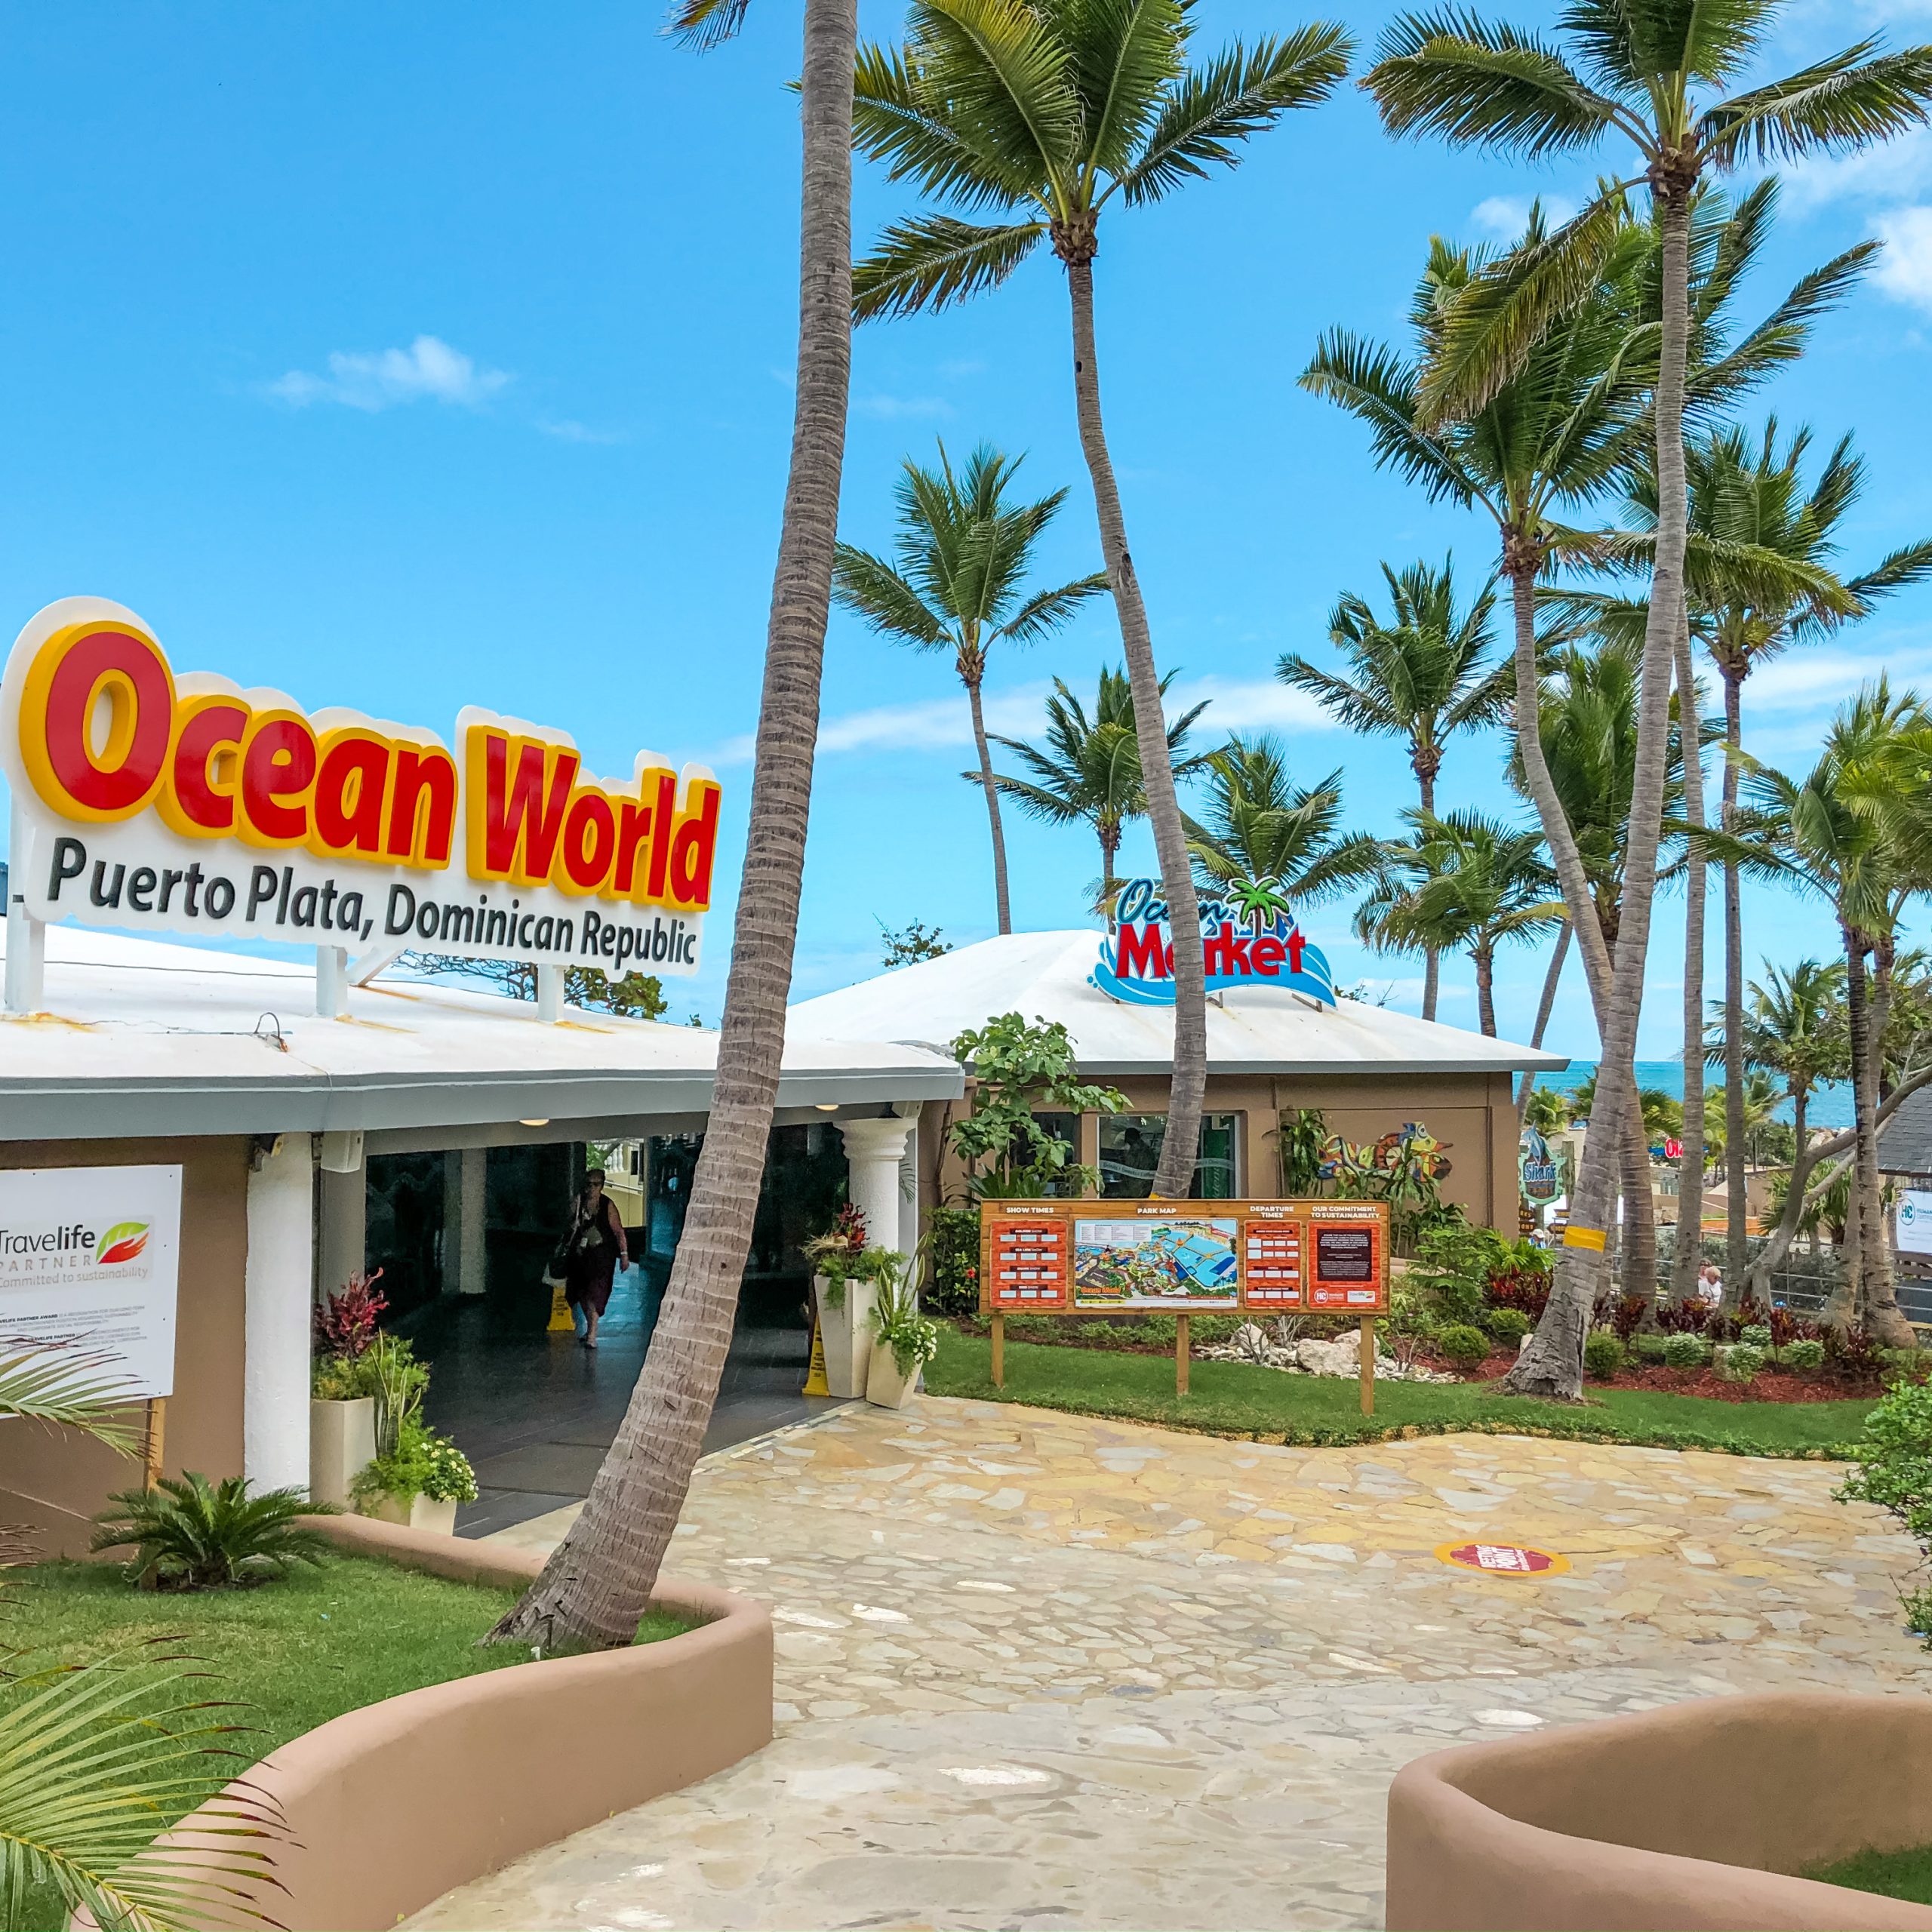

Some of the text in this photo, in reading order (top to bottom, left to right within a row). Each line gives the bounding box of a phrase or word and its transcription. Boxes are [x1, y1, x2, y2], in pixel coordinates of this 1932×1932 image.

[19, 620, 722, 912] Ocean World
[47, 837, 697, 971] Puerto Plata, Dominican Republic
[1115, 921, 1306, 979] Mrket
[1524, 1161, 1557, 1182] Shark
[63, 1273, 74, 1284] to
[77, 1266, 149, 1282] sustainability
